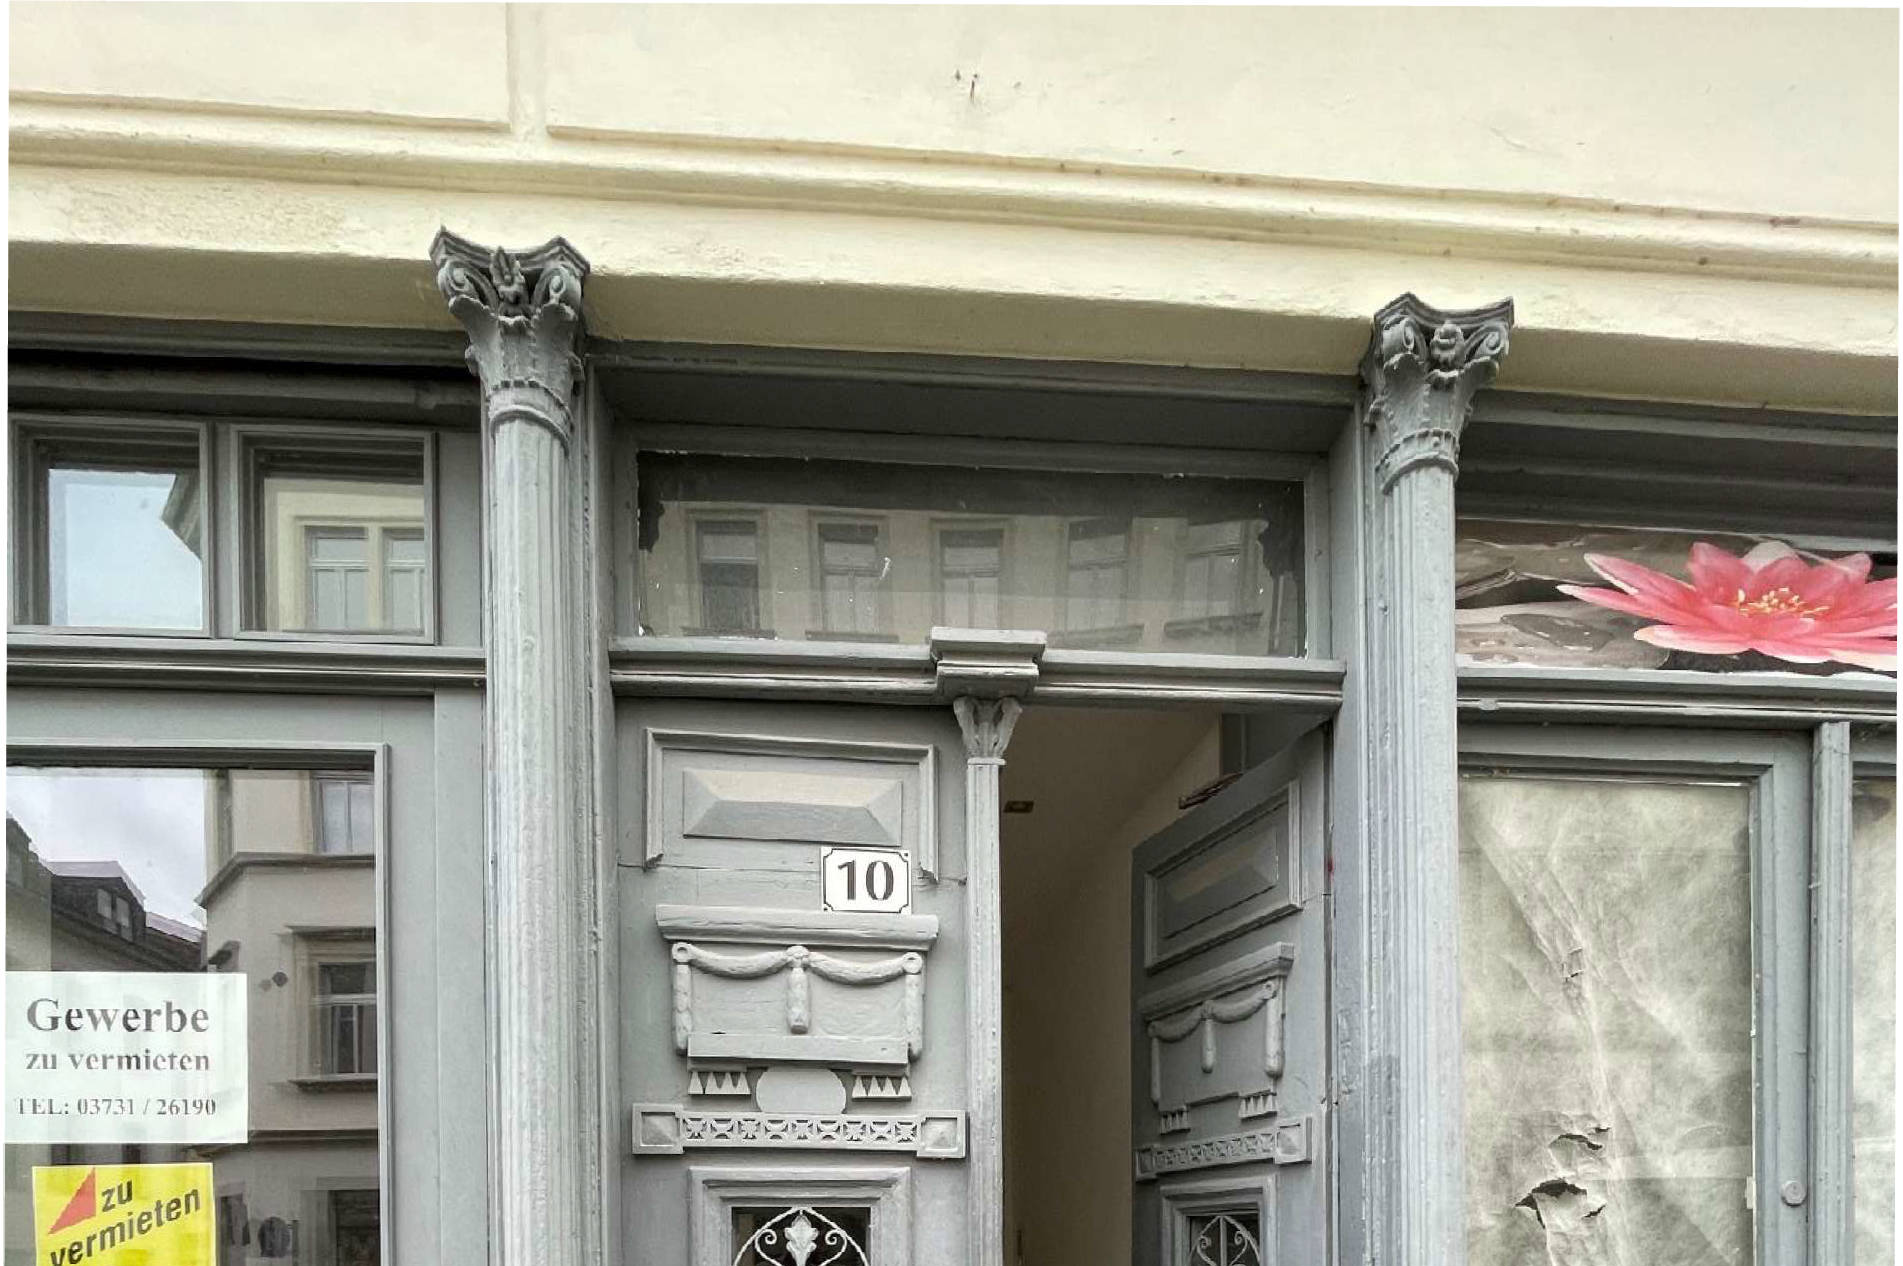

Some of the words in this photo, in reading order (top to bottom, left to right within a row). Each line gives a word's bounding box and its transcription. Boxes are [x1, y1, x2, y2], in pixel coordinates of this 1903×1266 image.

[837, 859, 895, 901] 10
[26, 998, 210, 1032] Gewerbe
[25, 1052, 58, 1071] zu
[67, 1048, 211, 1072] vermieten
[14, 1098, 70, 1116] TEL:
[77, 1098, 135, 1116] 03731
[156, 1098, 217, 1116] 26190
[101, 1180, 133, 1213] zu
